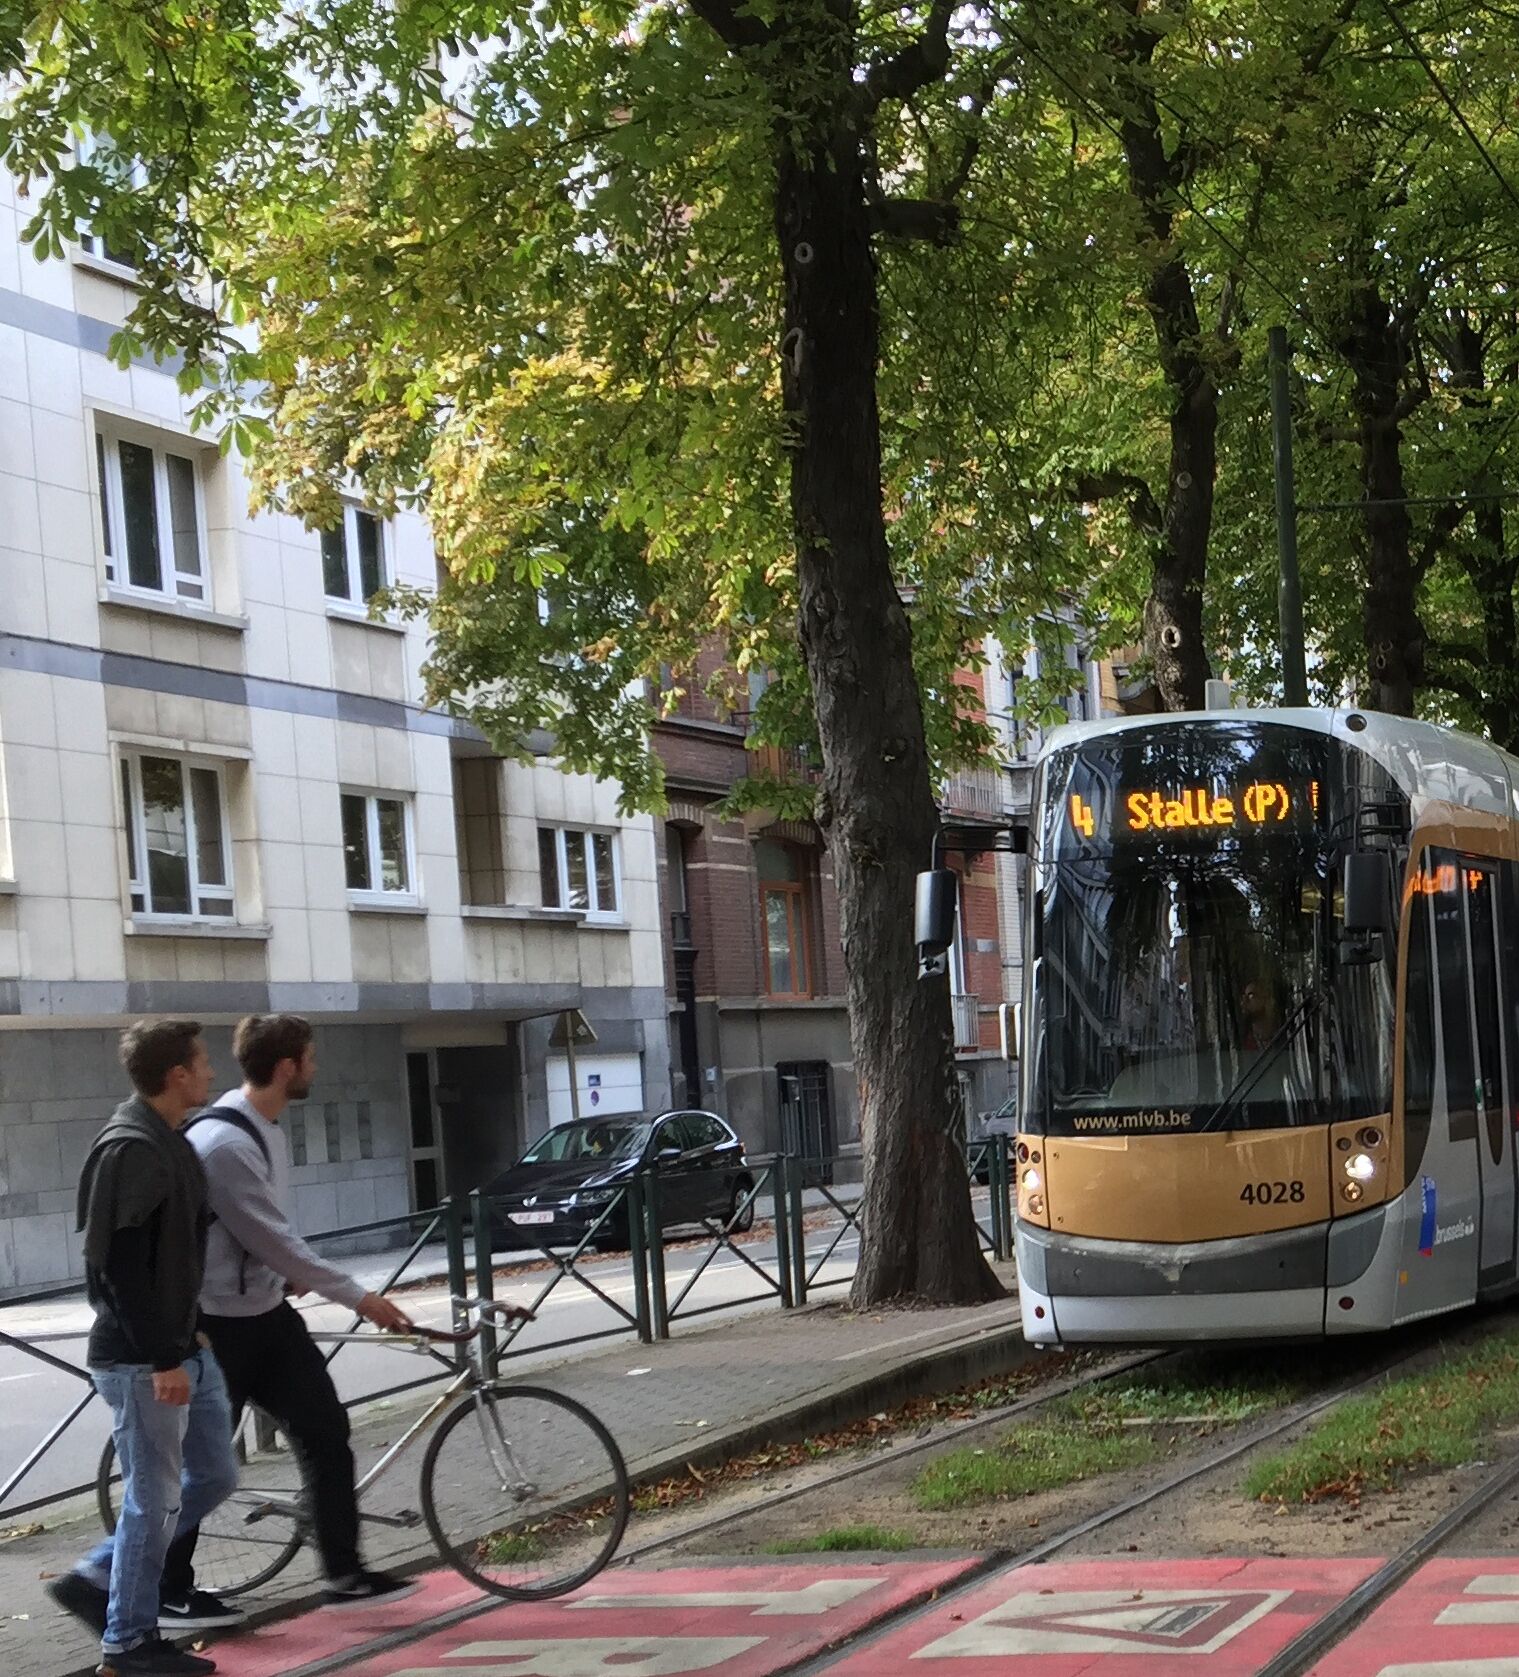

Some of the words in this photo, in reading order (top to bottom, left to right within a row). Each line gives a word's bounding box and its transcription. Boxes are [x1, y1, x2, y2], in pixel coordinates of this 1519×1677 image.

[1071, 794, 1095, 836] 4
[1127, 789, 1235, 830] Stalle
[1243, 783, 1289, 822] (P)
[1073, 1108, 1191, 1130] www.mivb.be
[1239, 1181, 1305, 1205] 4028
